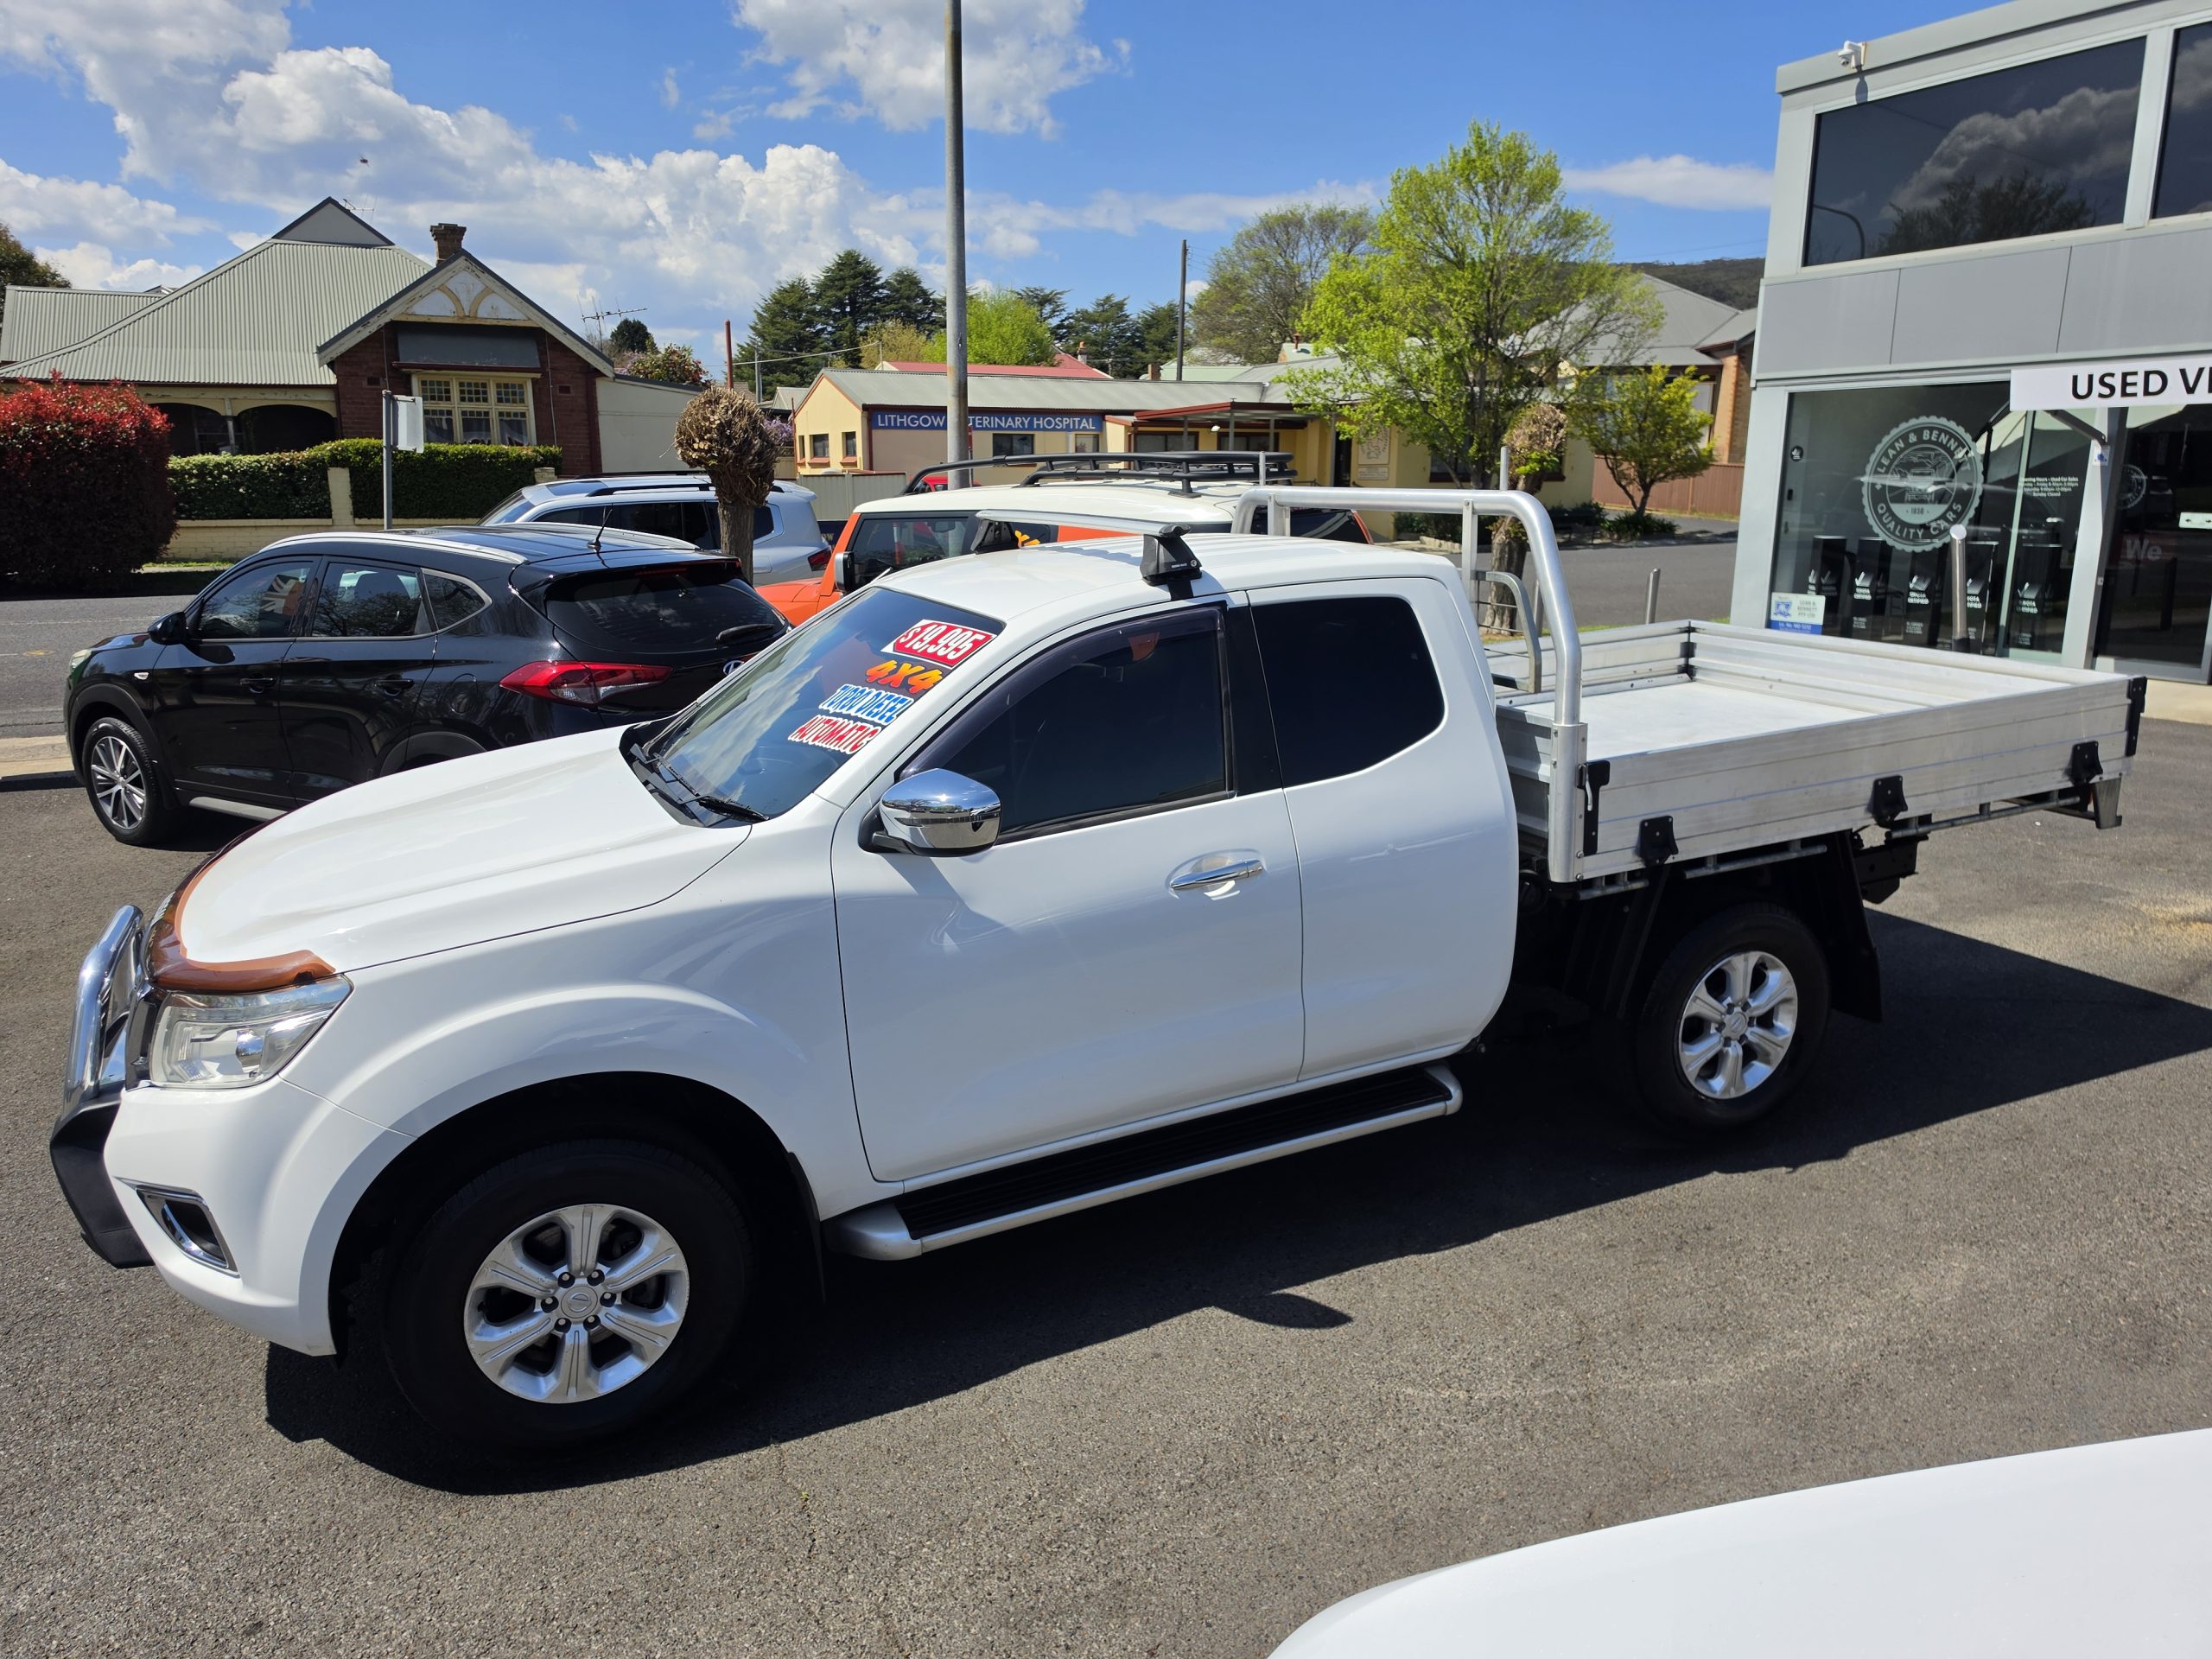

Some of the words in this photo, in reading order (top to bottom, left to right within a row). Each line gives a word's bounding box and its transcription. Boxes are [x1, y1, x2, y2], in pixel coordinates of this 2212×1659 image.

[2071, 370, 2168, 400] USED
[877, 414, 945, 428] LITHGOW
[967, 416, 1031, 429] TERINARY
[1033, 416, 1096, 429] HOSPITAL
[1877, 437, 1905, 474] LEAN
[1908, 432, 1917, 443] &
[1877, 503, 1924, 539] QUALITY
[1929, 502, 1962, 535] CARS
[899, 623, 986, 660] $19,995
[822, 683, 873, 715] TURBO
[865, 689, 914, 725] DIESEL
[790, 715, 881, 753] AUTOMATIC
